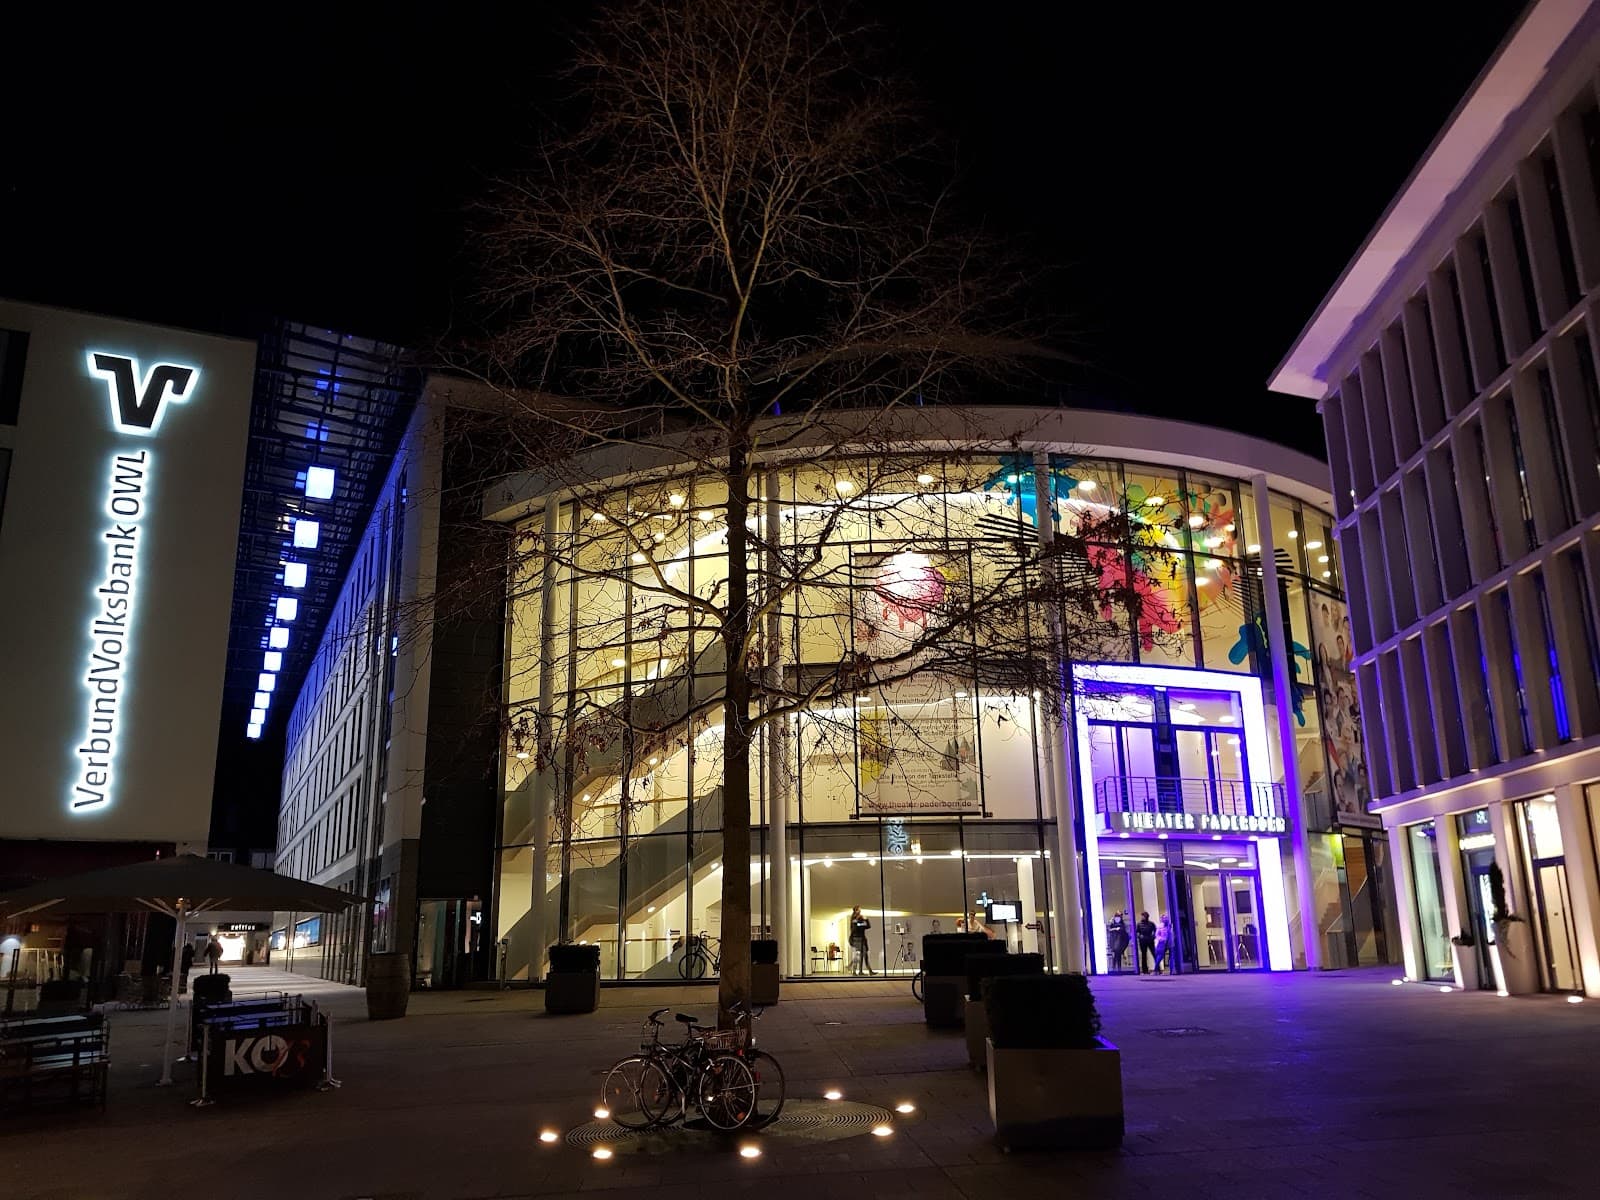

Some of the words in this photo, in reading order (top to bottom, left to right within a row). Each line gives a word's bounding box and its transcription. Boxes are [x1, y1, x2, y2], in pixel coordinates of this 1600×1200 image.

[74, 523, 137, 808] VerbundVolksbank
[111, 450, 146, 516] OWL
[1122, 812, 1195, 829] THEATER
[1201, 814, 1286, 832] PADERBORN
